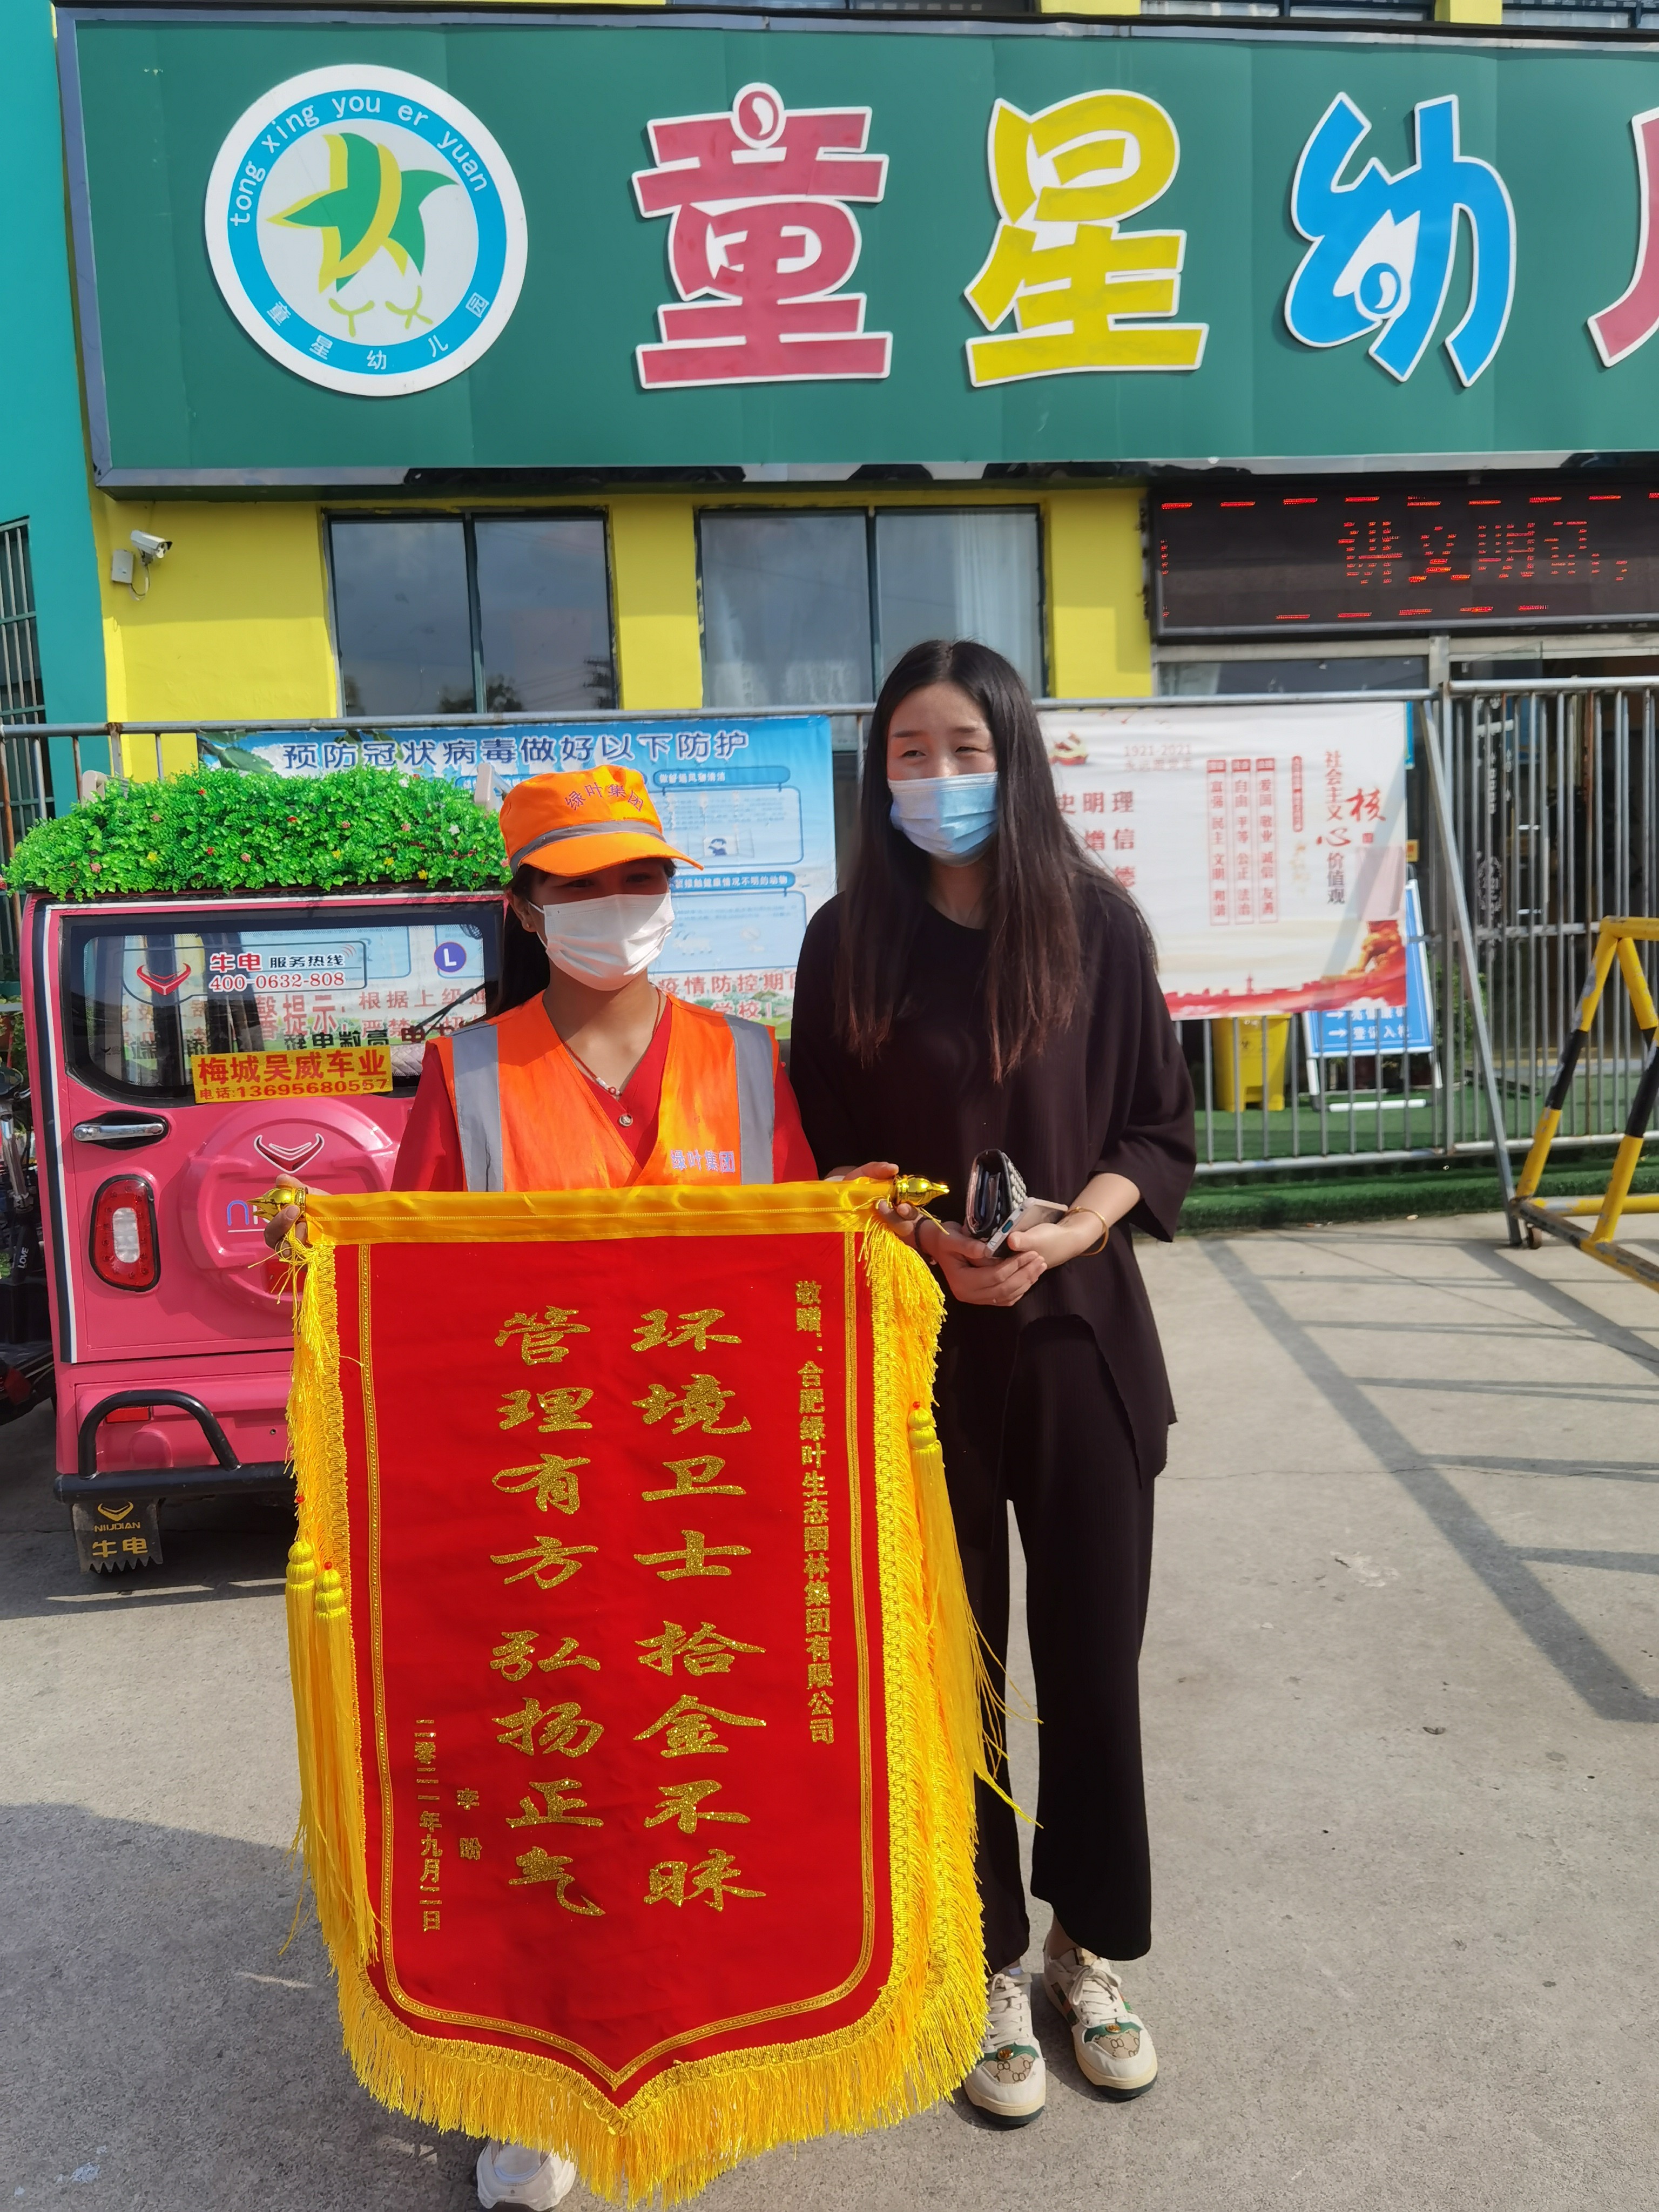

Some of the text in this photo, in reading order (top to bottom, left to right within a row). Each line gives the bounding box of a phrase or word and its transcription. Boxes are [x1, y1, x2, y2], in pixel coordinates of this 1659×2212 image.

[230, 95, 487, 226] tong xing you er yuan
[267, 292, 490, 370] 童星幼儿园
[282, 731, 747, 768] 预防冠状病毒做好以下防护
[564, 782, 644, 812] 绿叶集团
[210, 952, 345, 972] 牛电 服务热线
[210, 972, 345, 992] 400-0632-808
[658, 973, 795, 995] 疫情防控期
[198, 1049, 386, 1084] 梅城吴威车业
[17, 1246, 29, 1268] LOVE
[93, 1521, 140, 1533] NIUDIAN
[92, 1537, 148, 1557] 牛电
